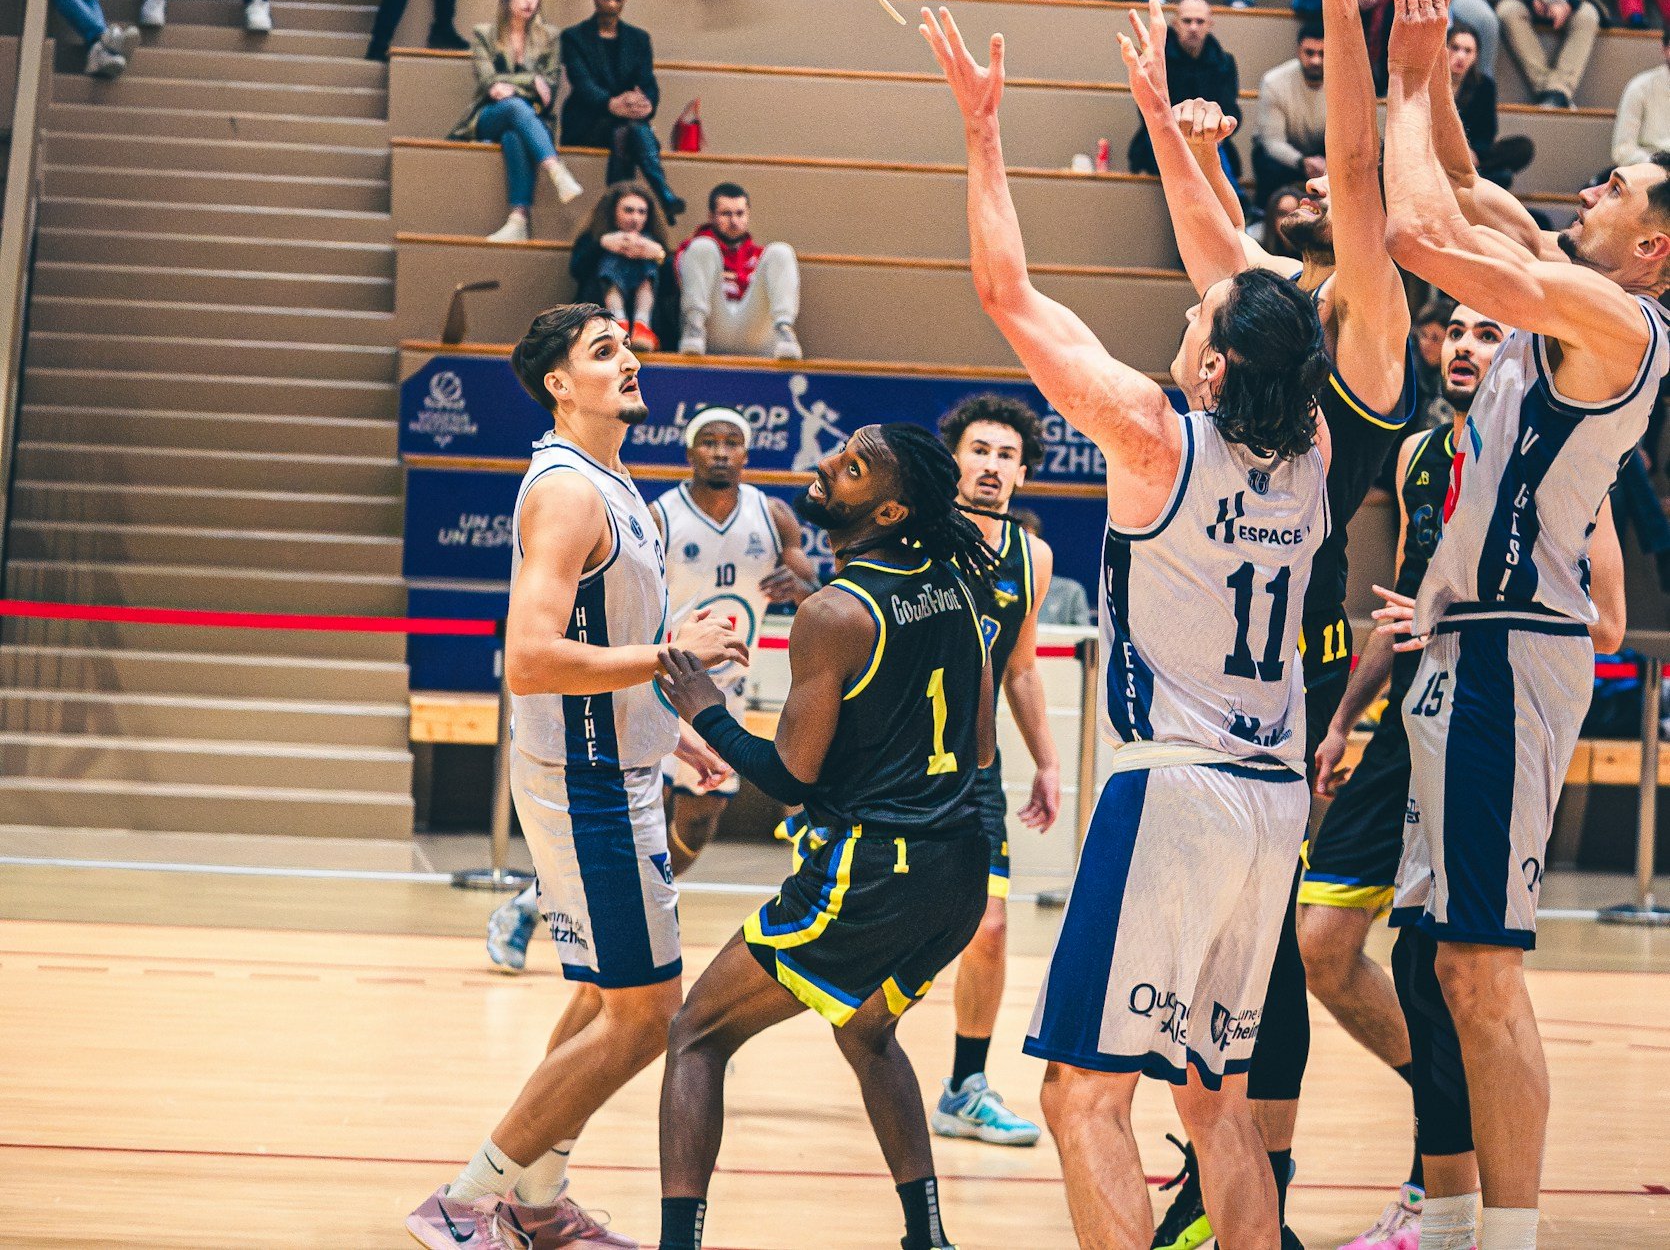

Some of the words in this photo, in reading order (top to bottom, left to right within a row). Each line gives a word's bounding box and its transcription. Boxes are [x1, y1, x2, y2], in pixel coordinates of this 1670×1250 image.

[1239, 524, 1303, 546] ESPACE
[715, 563, 736, 587] 10
[1224, 560, 1291, 682] 11
[1321, 619, 1348, 664] 11
[1411, 670, 1449, 717] 15
[926, 667, 958, 776] 1
[893, 837, 909, 873] 1
